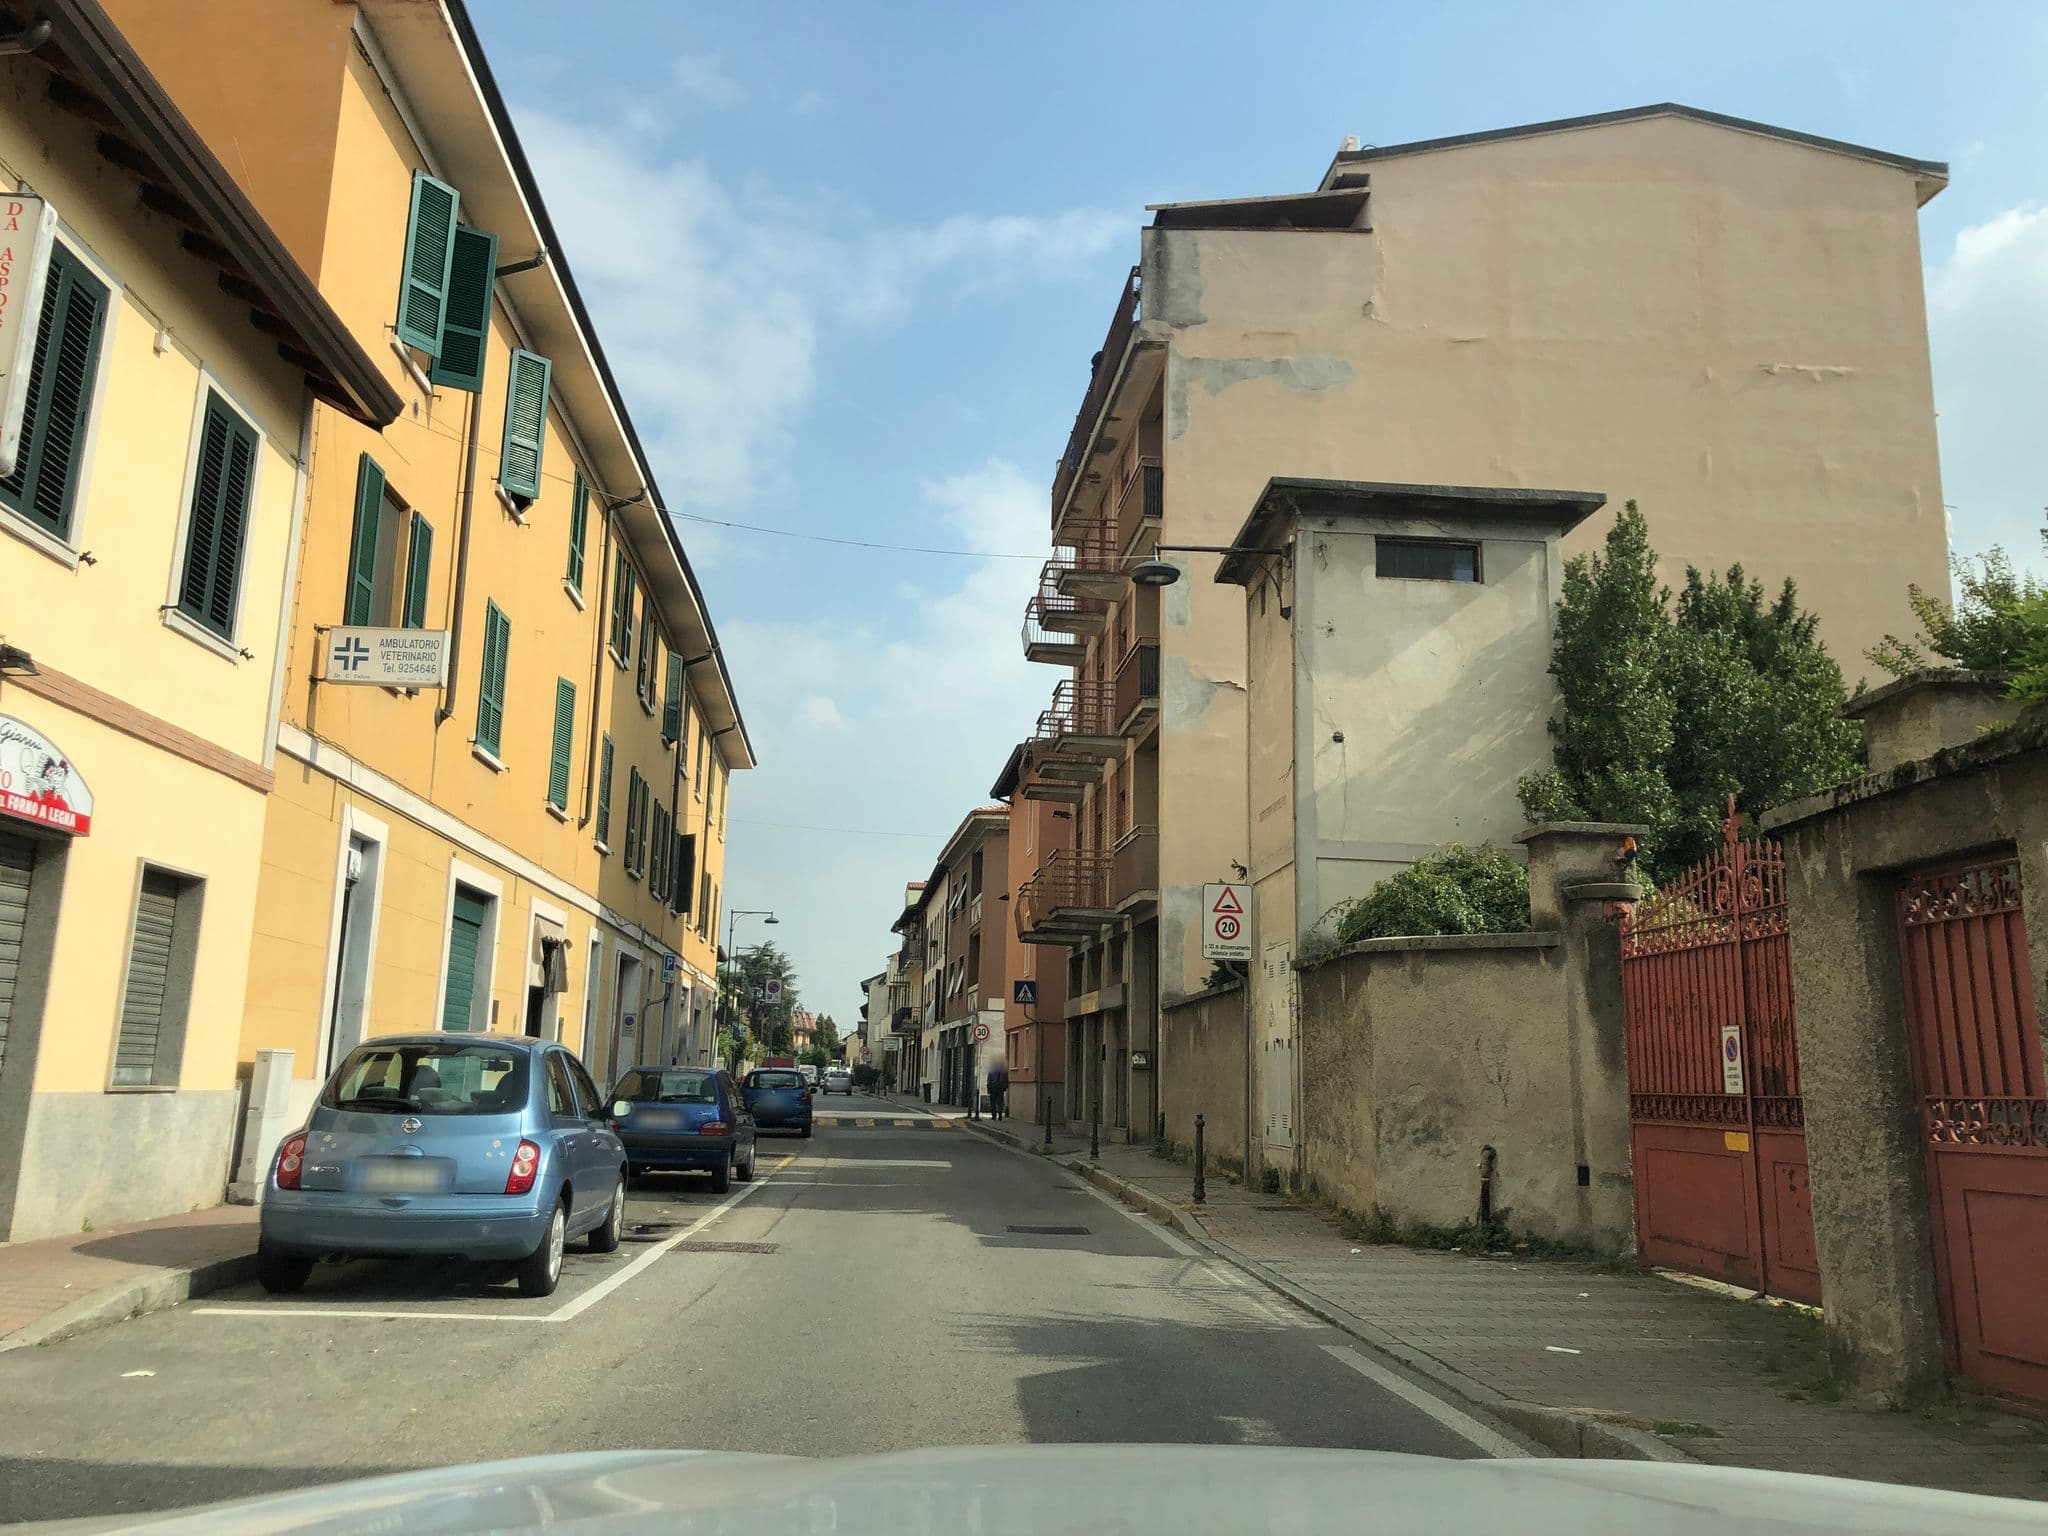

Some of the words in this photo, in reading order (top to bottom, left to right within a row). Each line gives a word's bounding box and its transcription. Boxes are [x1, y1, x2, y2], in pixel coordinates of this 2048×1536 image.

[379, 637, 440, 650] AMBULATORIO
[380, 650, 437, 662] VETERINARIO
[382, 662, 396, 673] Tel.
[398, 663, 437, 674] 9254646
[7, 794, 39, 816] FORNO
[39, 803, 48, 819] A
[48, 806, 77, 828] LEGNA
[1222, 921, 1235, 933] 20
[977, 1028, 986, 1036] 30
